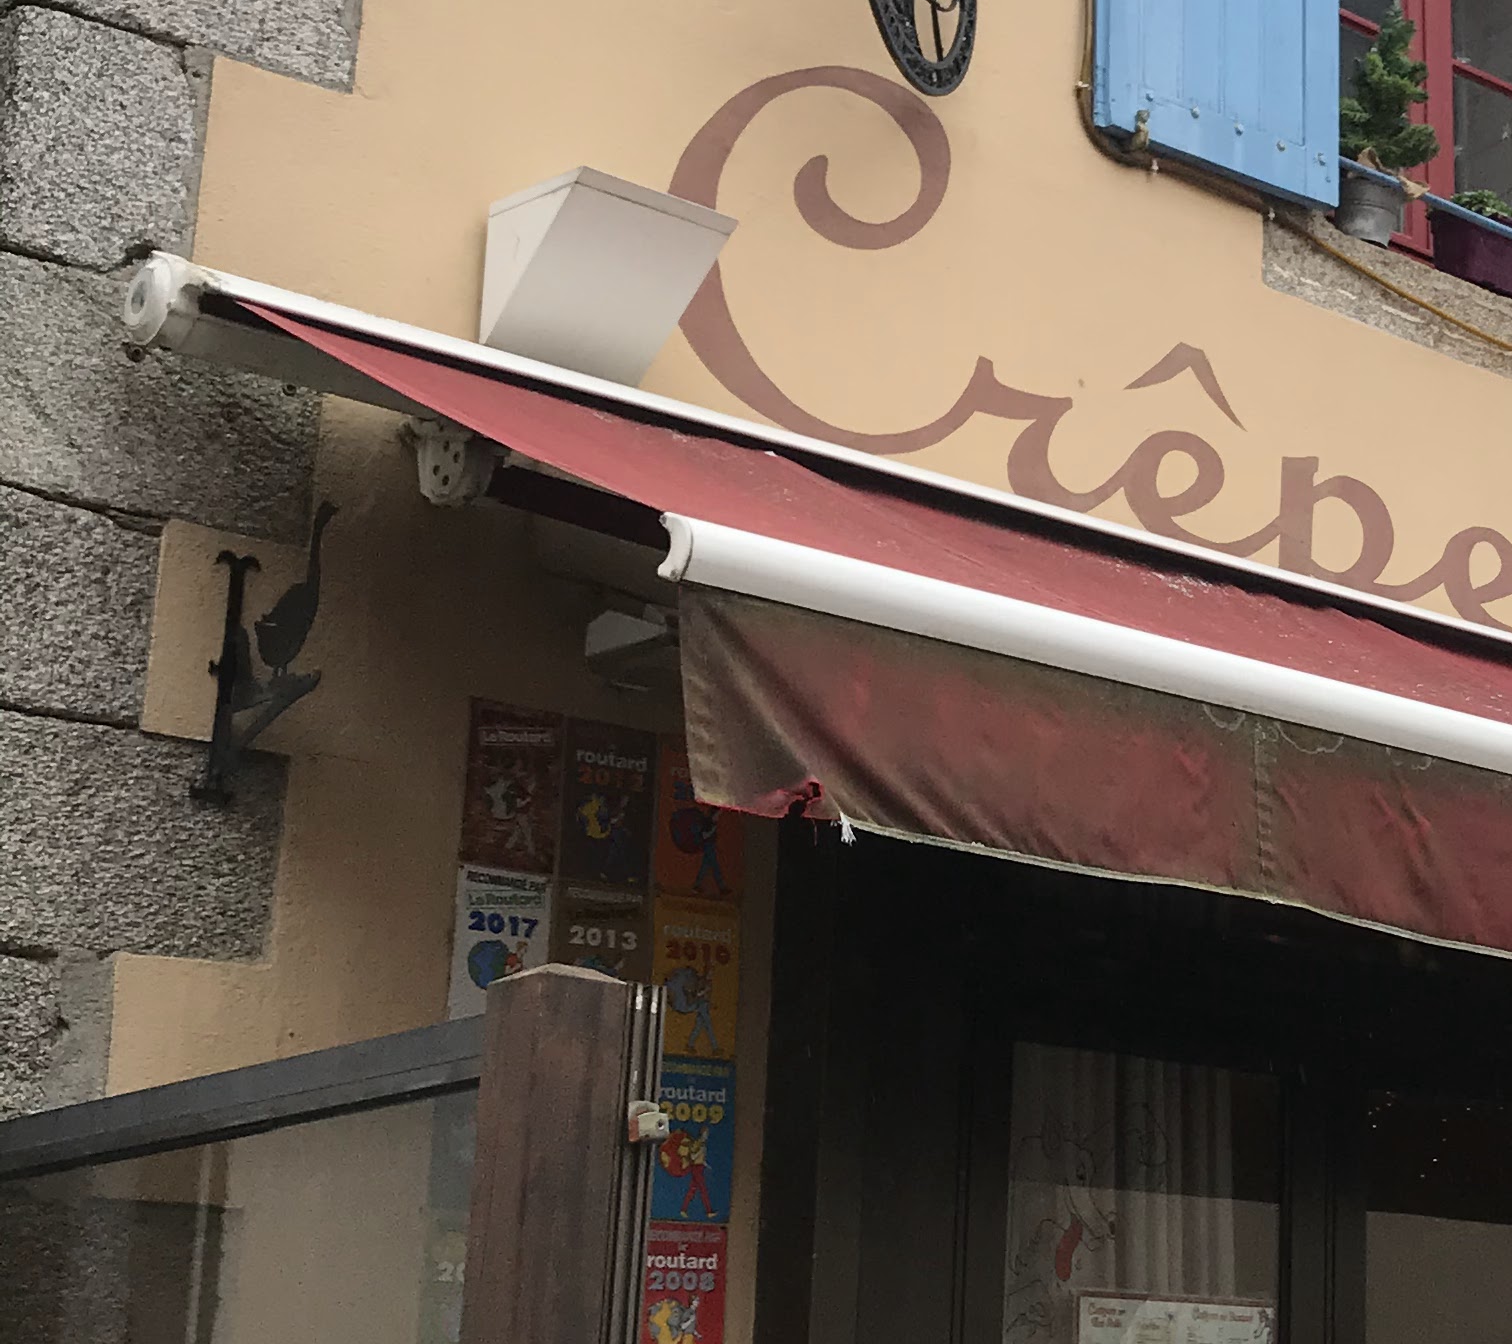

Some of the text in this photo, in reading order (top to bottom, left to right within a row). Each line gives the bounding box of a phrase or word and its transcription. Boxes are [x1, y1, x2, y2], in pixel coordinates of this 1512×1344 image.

[576, 749, 648, 773] routard
[468, 910, 538, 938] 2017
[568, 924, 637, 951] 2013
[659, 1100, 724, 1124] 2009
[647, 1252, 718, 1270] routard
[648, 1269, 715, 1292] 2008
